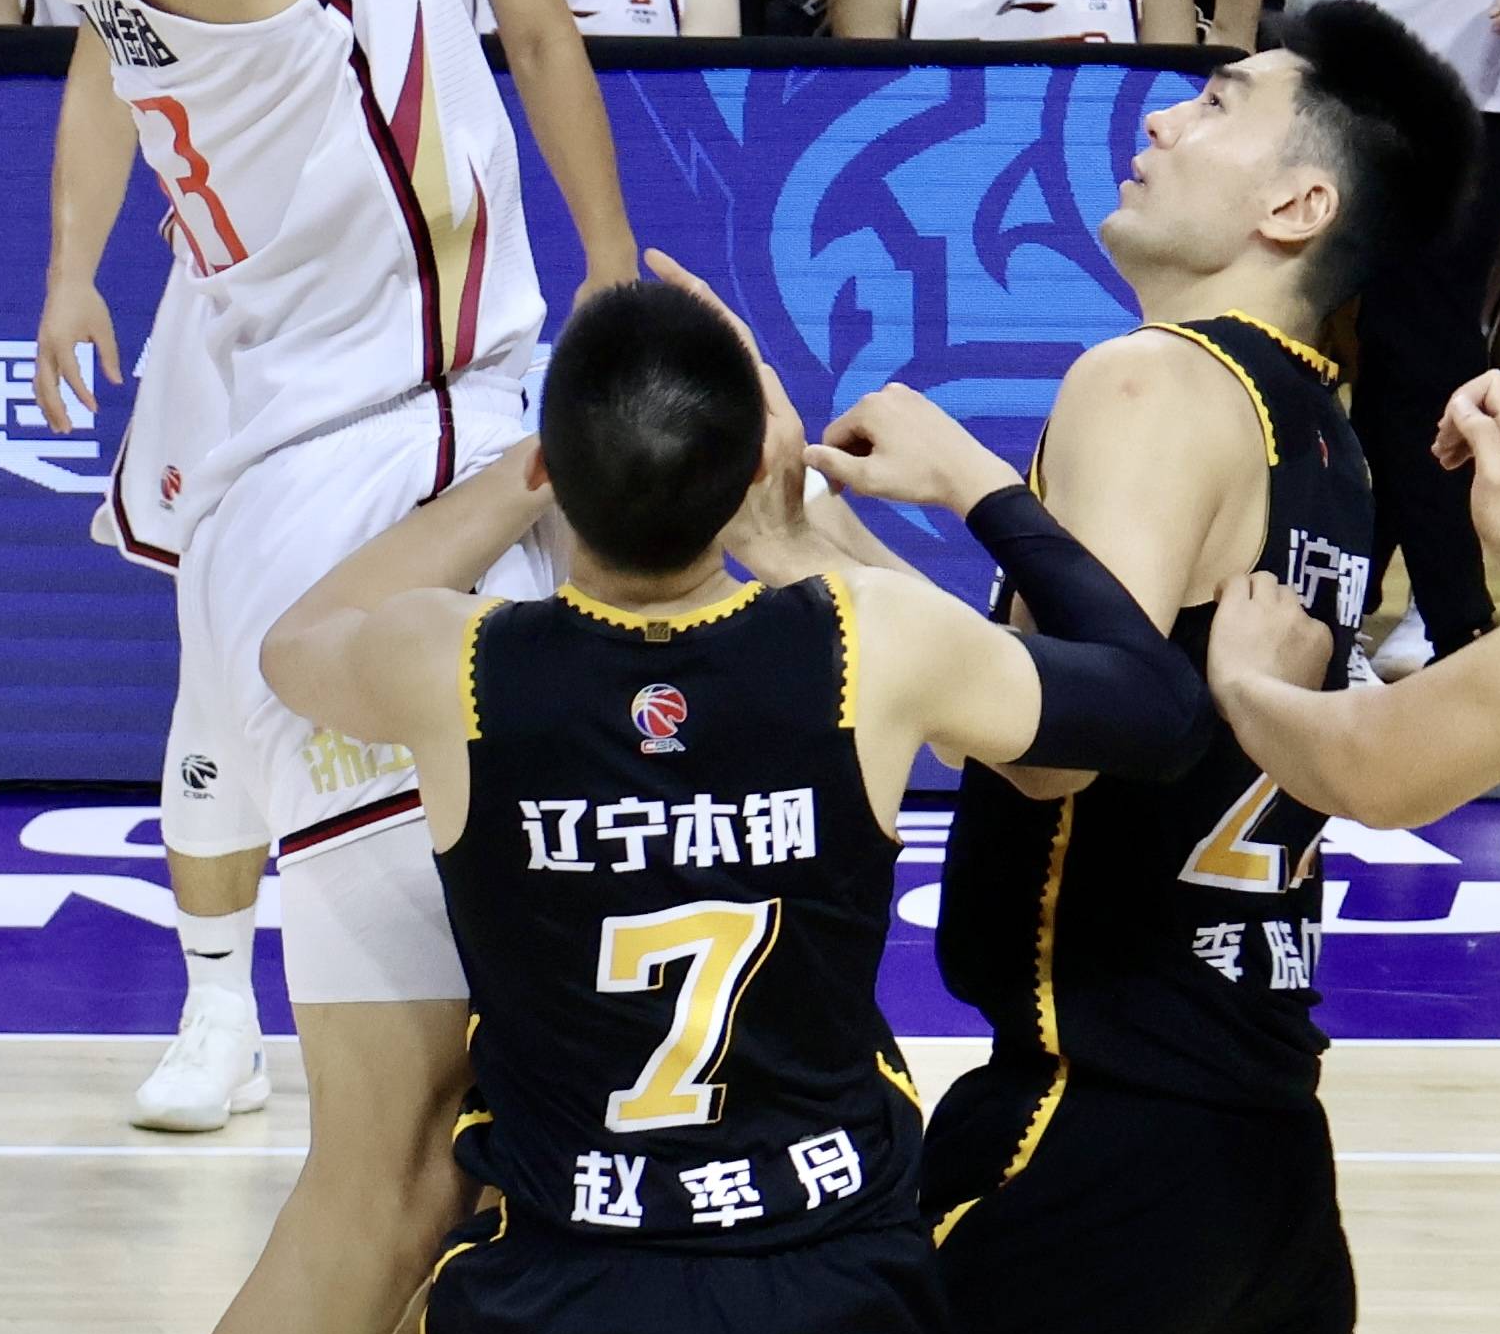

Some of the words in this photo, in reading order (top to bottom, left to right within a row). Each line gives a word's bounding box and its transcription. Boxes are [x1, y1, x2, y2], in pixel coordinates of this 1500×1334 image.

[518, 787, 817, 874] 辽宁本钢
[596, 897, 781, 1133] 7
